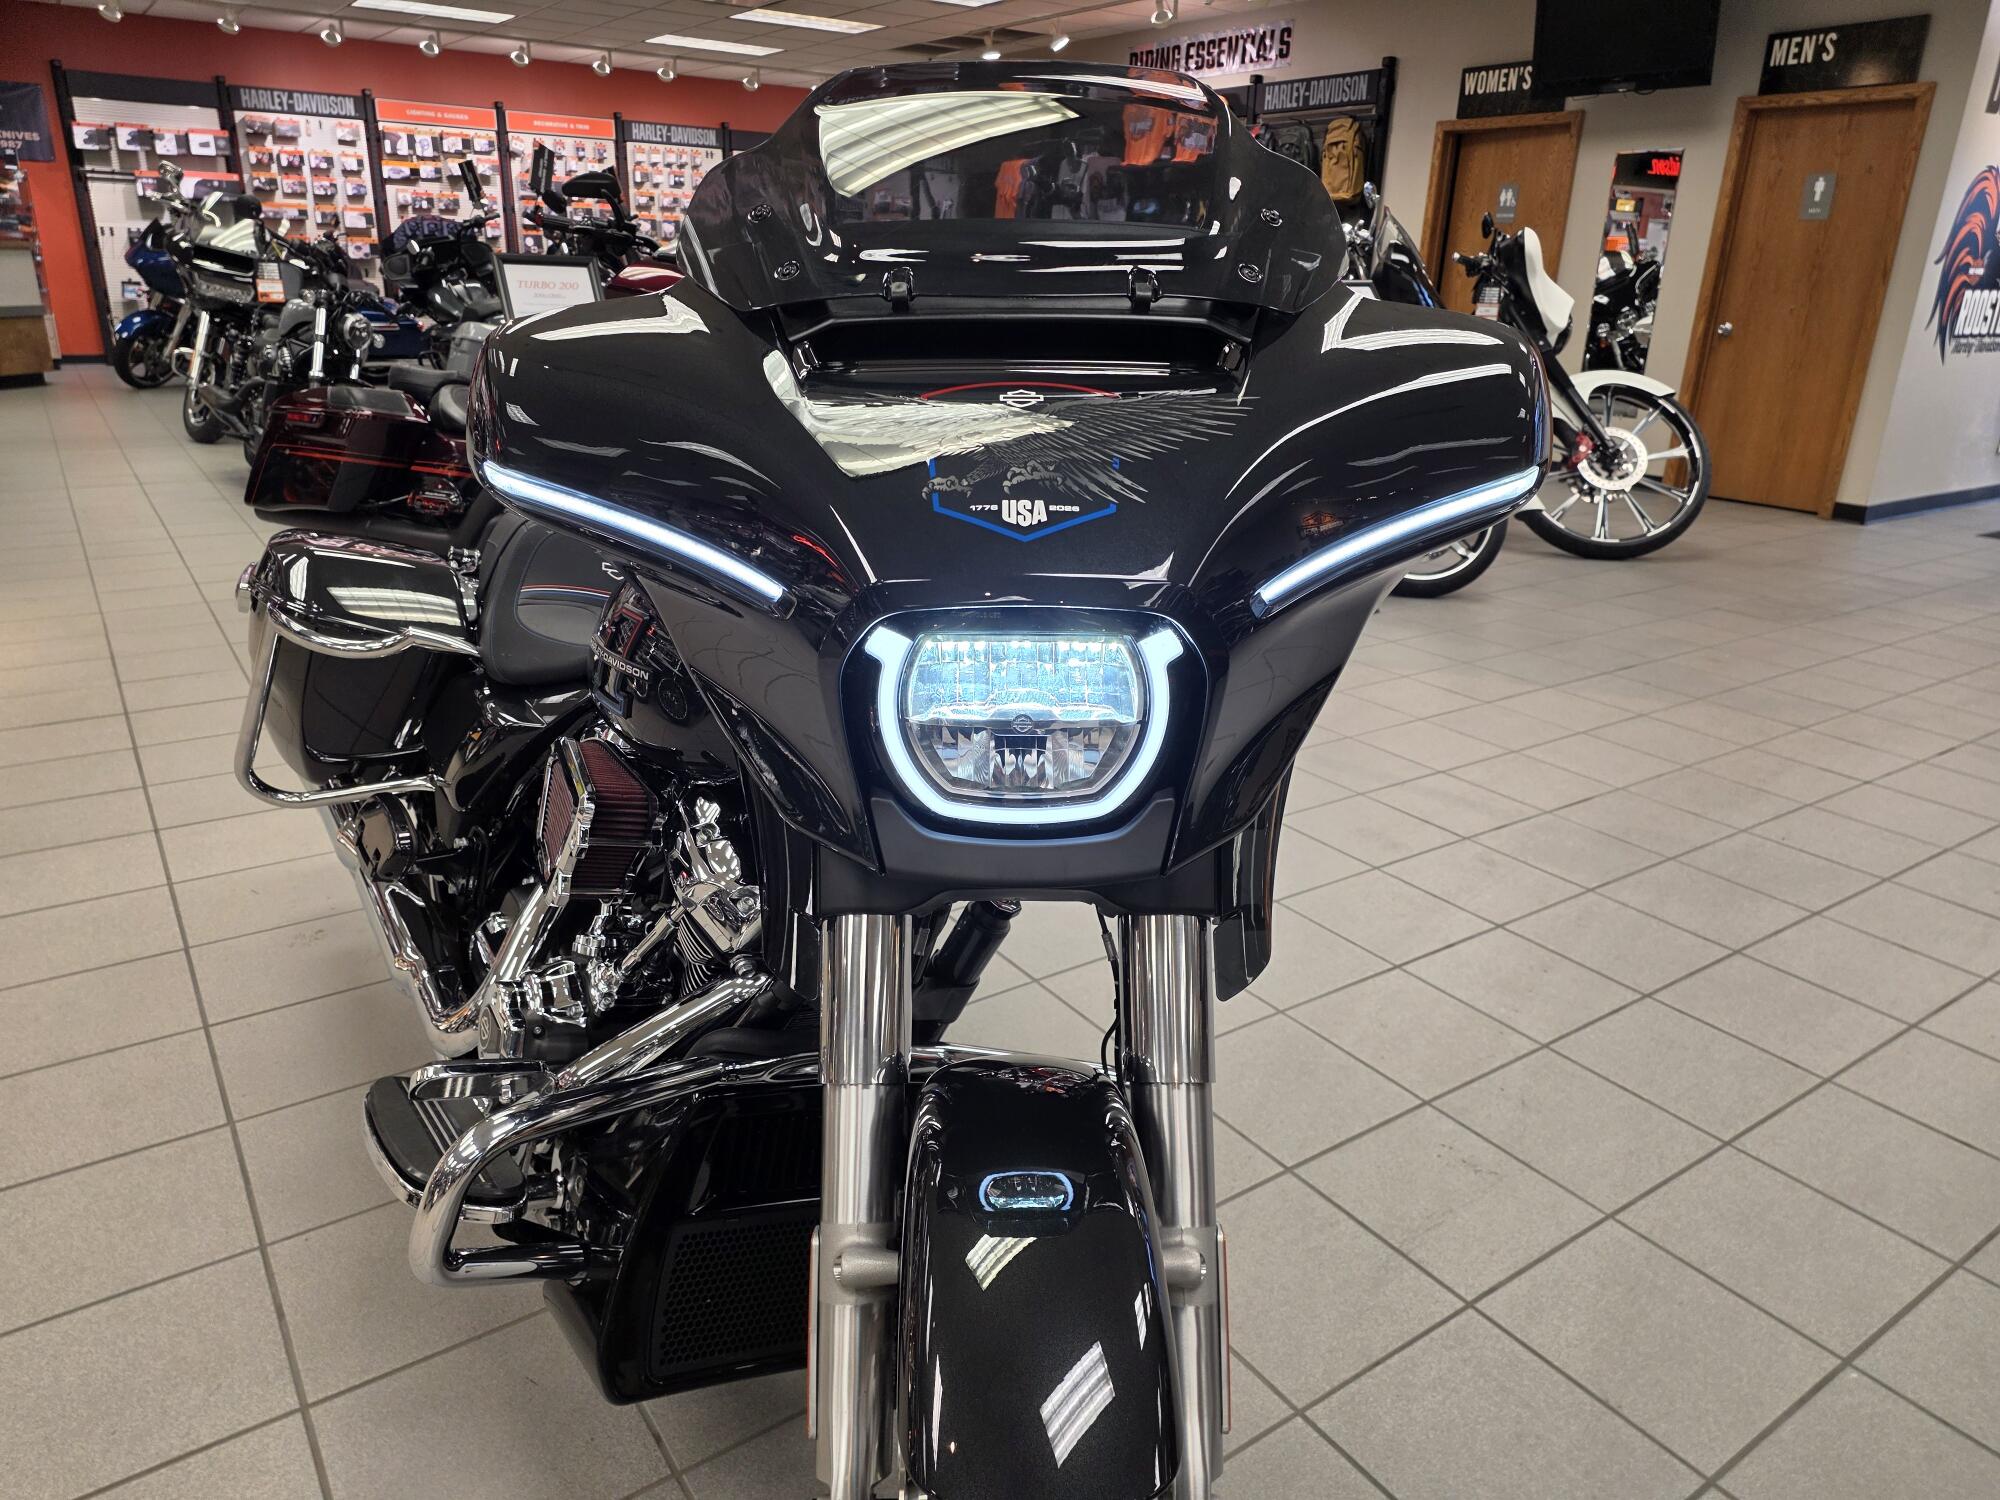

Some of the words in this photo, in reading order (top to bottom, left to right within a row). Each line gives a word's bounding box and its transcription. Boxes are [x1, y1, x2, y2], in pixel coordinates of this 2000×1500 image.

[1185, 26, 1292, 72] ESSENTIALS
[1769, 32, 1838, 67] MEN'S
[1264, 74, 1368, 111] HARLEY-DAVIDSON
[1464, 65, 1533, 96] WOMEN'S
[240, 88, 356, 116] HARLEY-DAVIDSON
[631, 122, 717, 146] HARLEY-DAVIDSON
[517, 280, 556, 290] TURBO
[559, 280, 580, 290] 200
[969, 504, 999, 512] 1776
[1002, 499, 1048, 527] USA
[1048, 504, 1080, 512] 2026
